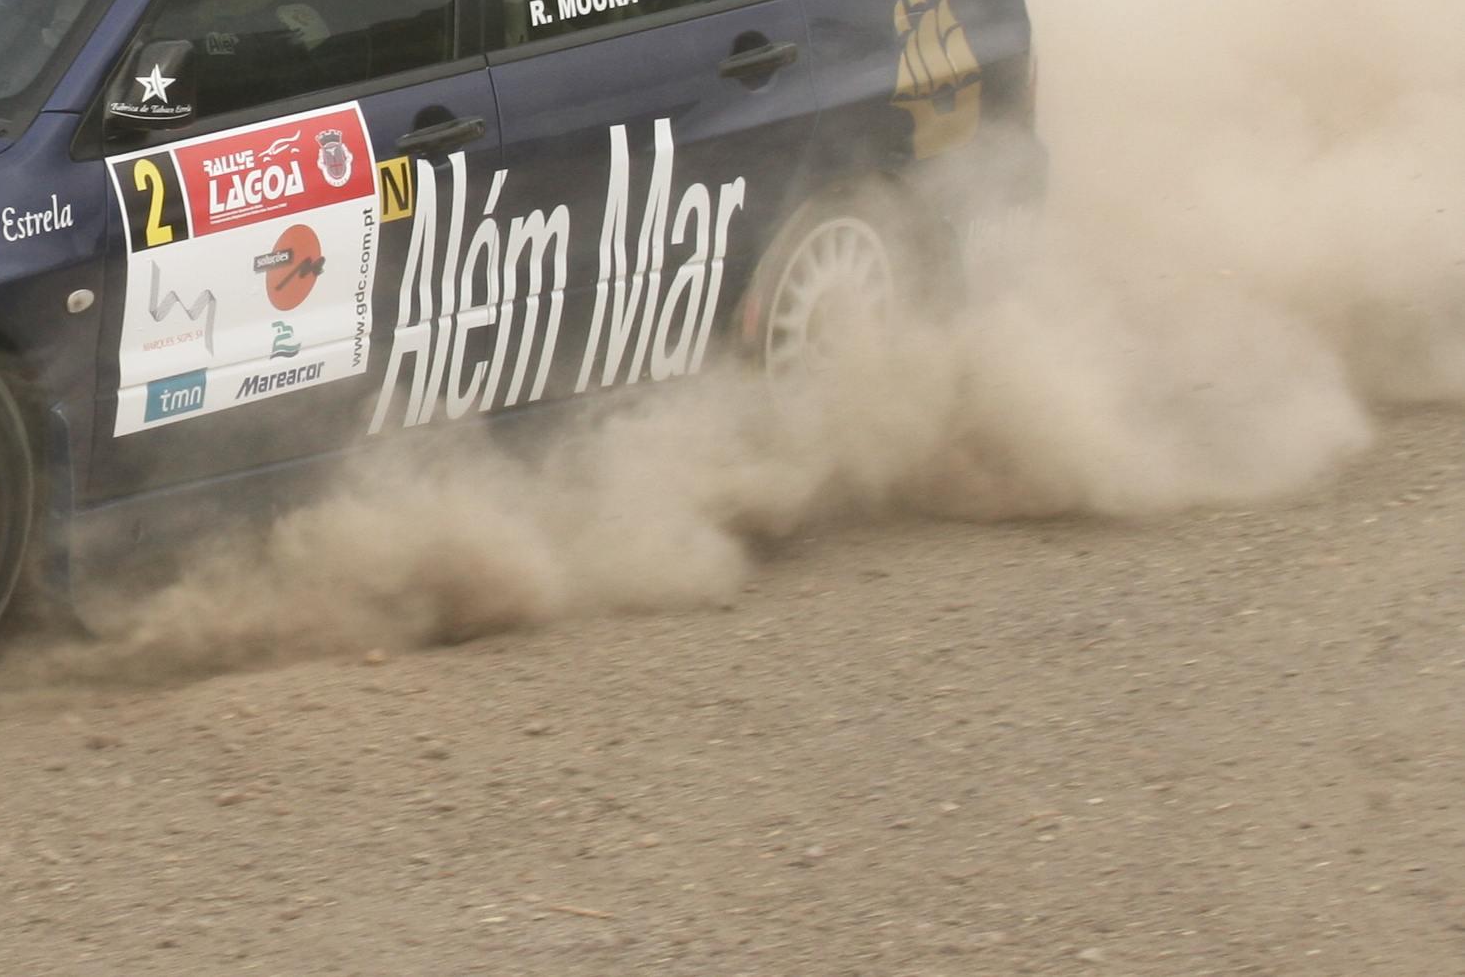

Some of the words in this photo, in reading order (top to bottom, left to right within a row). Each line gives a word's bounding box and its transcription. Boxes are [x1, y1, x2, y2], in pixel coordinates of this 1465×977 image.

[529, 0, 553, 27] R.
[203, 149, 255, 177] RALLYE
[209, 160, 305, 214] LAGOA
[380, 162, 410, 215] N
[1, 194, 75, 242] Estrela
[134, 158, 173, 247] 2
[351, 207, 375, 368] www.gdc.com.pt
[367, 151, 570, 435] Além
[574, 117, 746, 393] Mar
[160, 385, 202, 412] tmn
